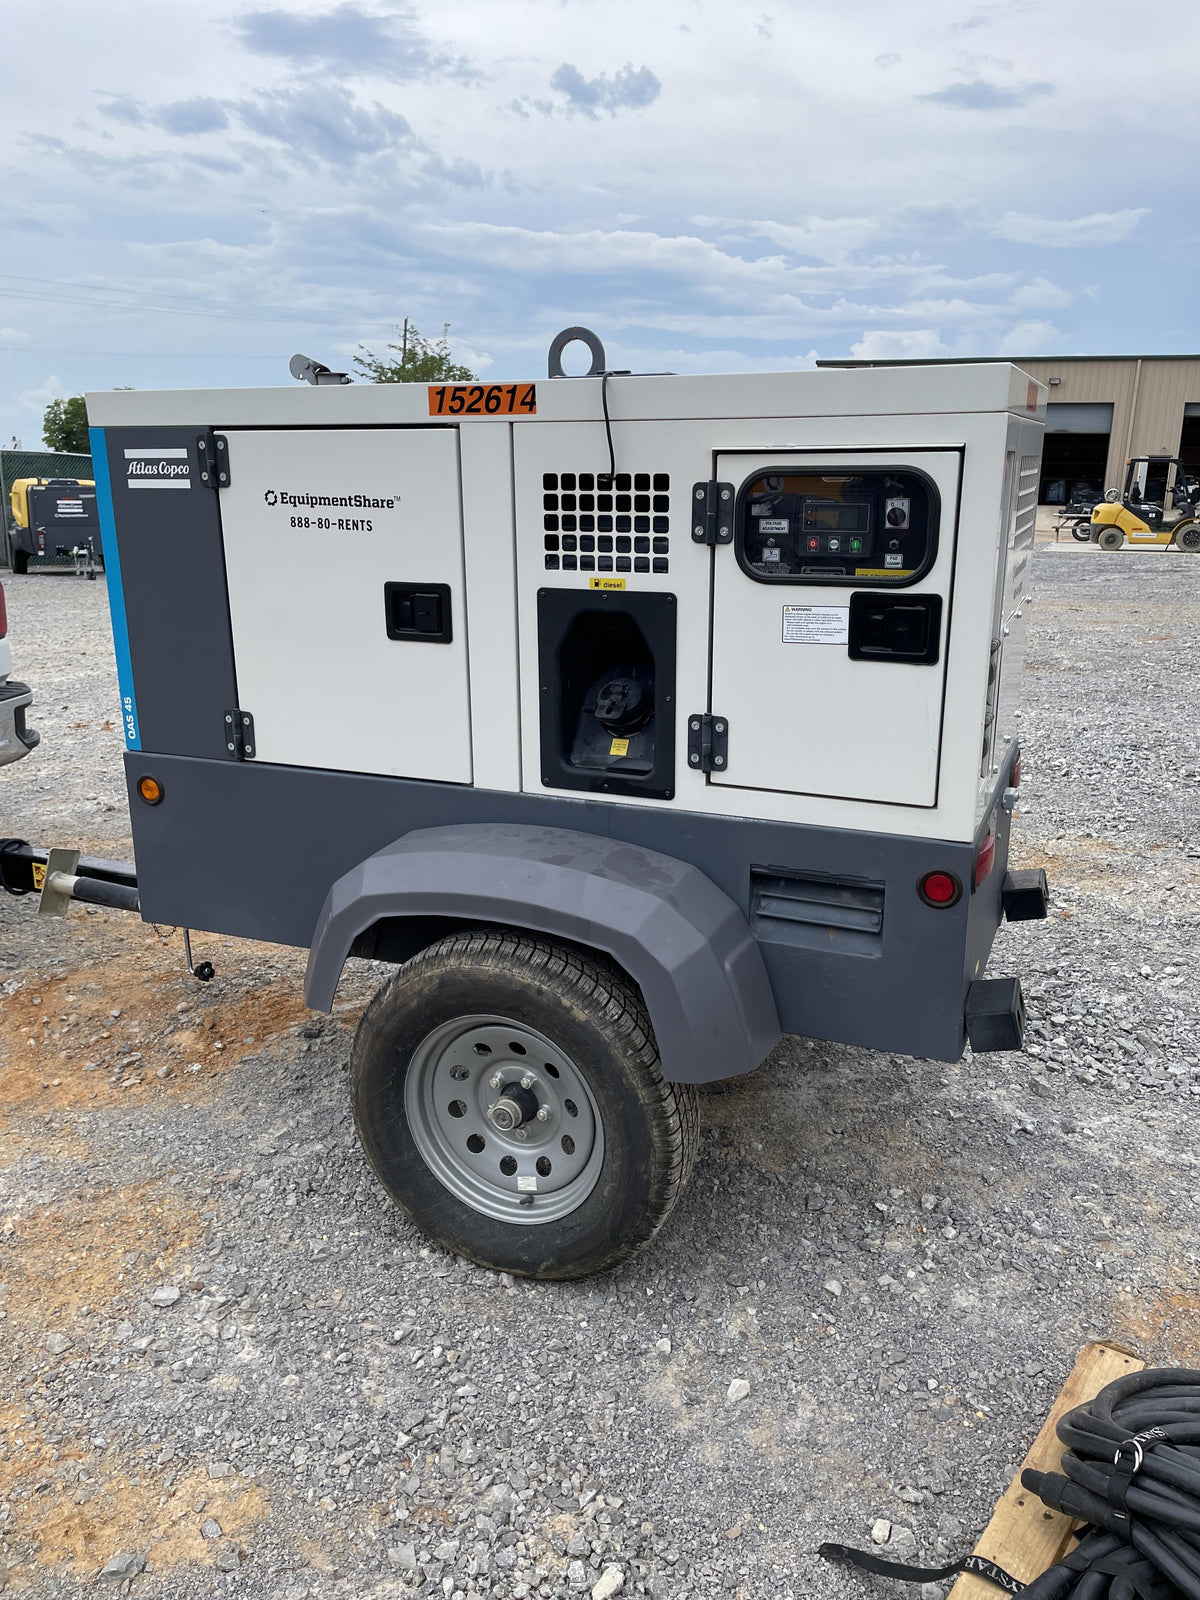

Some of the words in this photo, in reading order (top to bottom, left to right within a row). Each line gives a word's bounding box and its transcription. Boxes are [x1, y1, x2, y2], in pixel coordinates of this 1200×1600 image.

[435, 384, 536, 413] 152614
[126, 461, 158, 475] Atlas
[158, 461, 190, 477] Copco
[290, 516, 373, 531] 888-80-RENTS
[123, 696, 132, 712] 45
